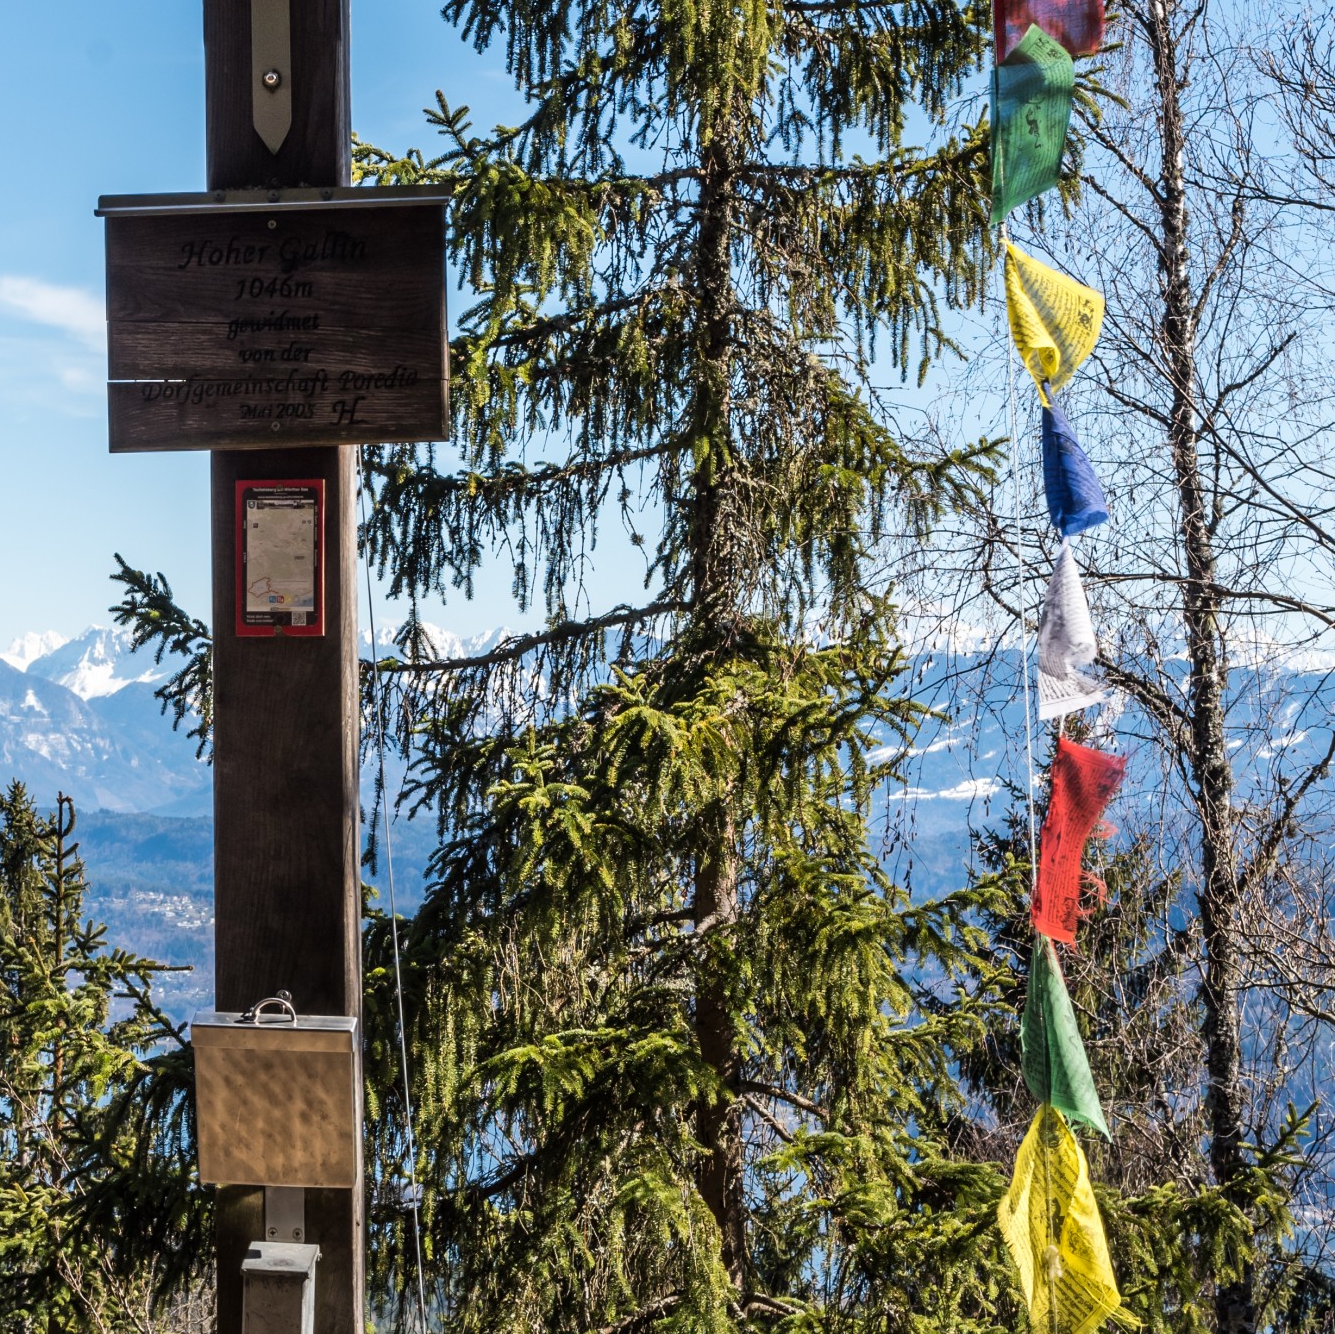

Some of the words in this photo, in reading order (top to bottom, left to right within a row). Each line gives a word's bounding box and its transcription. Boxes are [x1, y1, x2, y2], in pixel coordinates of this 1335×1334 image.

[178, 236, 270, 269] Hoher
[235, 275, 313, 300] 1046m
[227, 310, 321, 340] gewidmet
[239, 348, 276, 363] von
[281, 341, 314, 363] der
[142, 369, 329, 405] Dorfgemeinschaft
